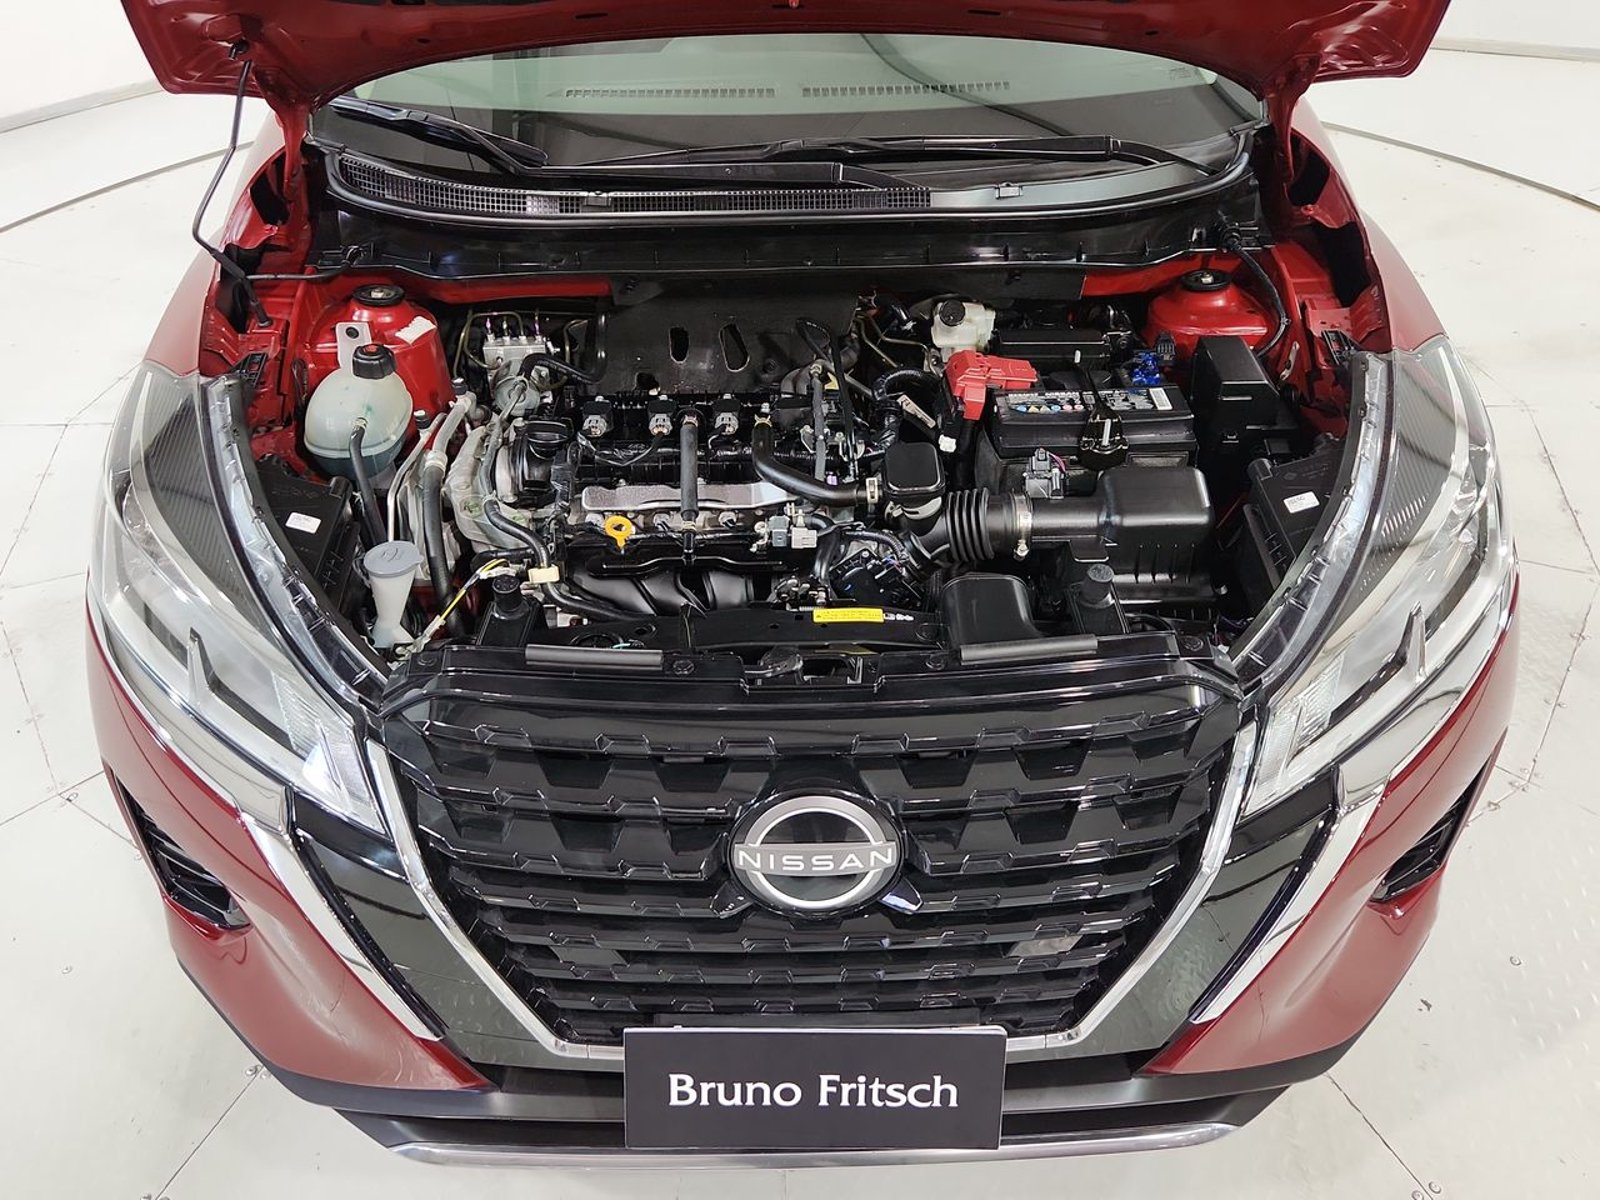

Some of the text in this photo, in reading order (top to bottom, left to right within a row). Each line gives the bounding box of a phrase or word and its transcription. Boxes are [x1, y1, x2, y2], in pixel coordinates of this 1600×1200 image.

[738, 847, 892, 871] NISSAN
[669, 1074, 959, 1107] Bruno Fritsch
